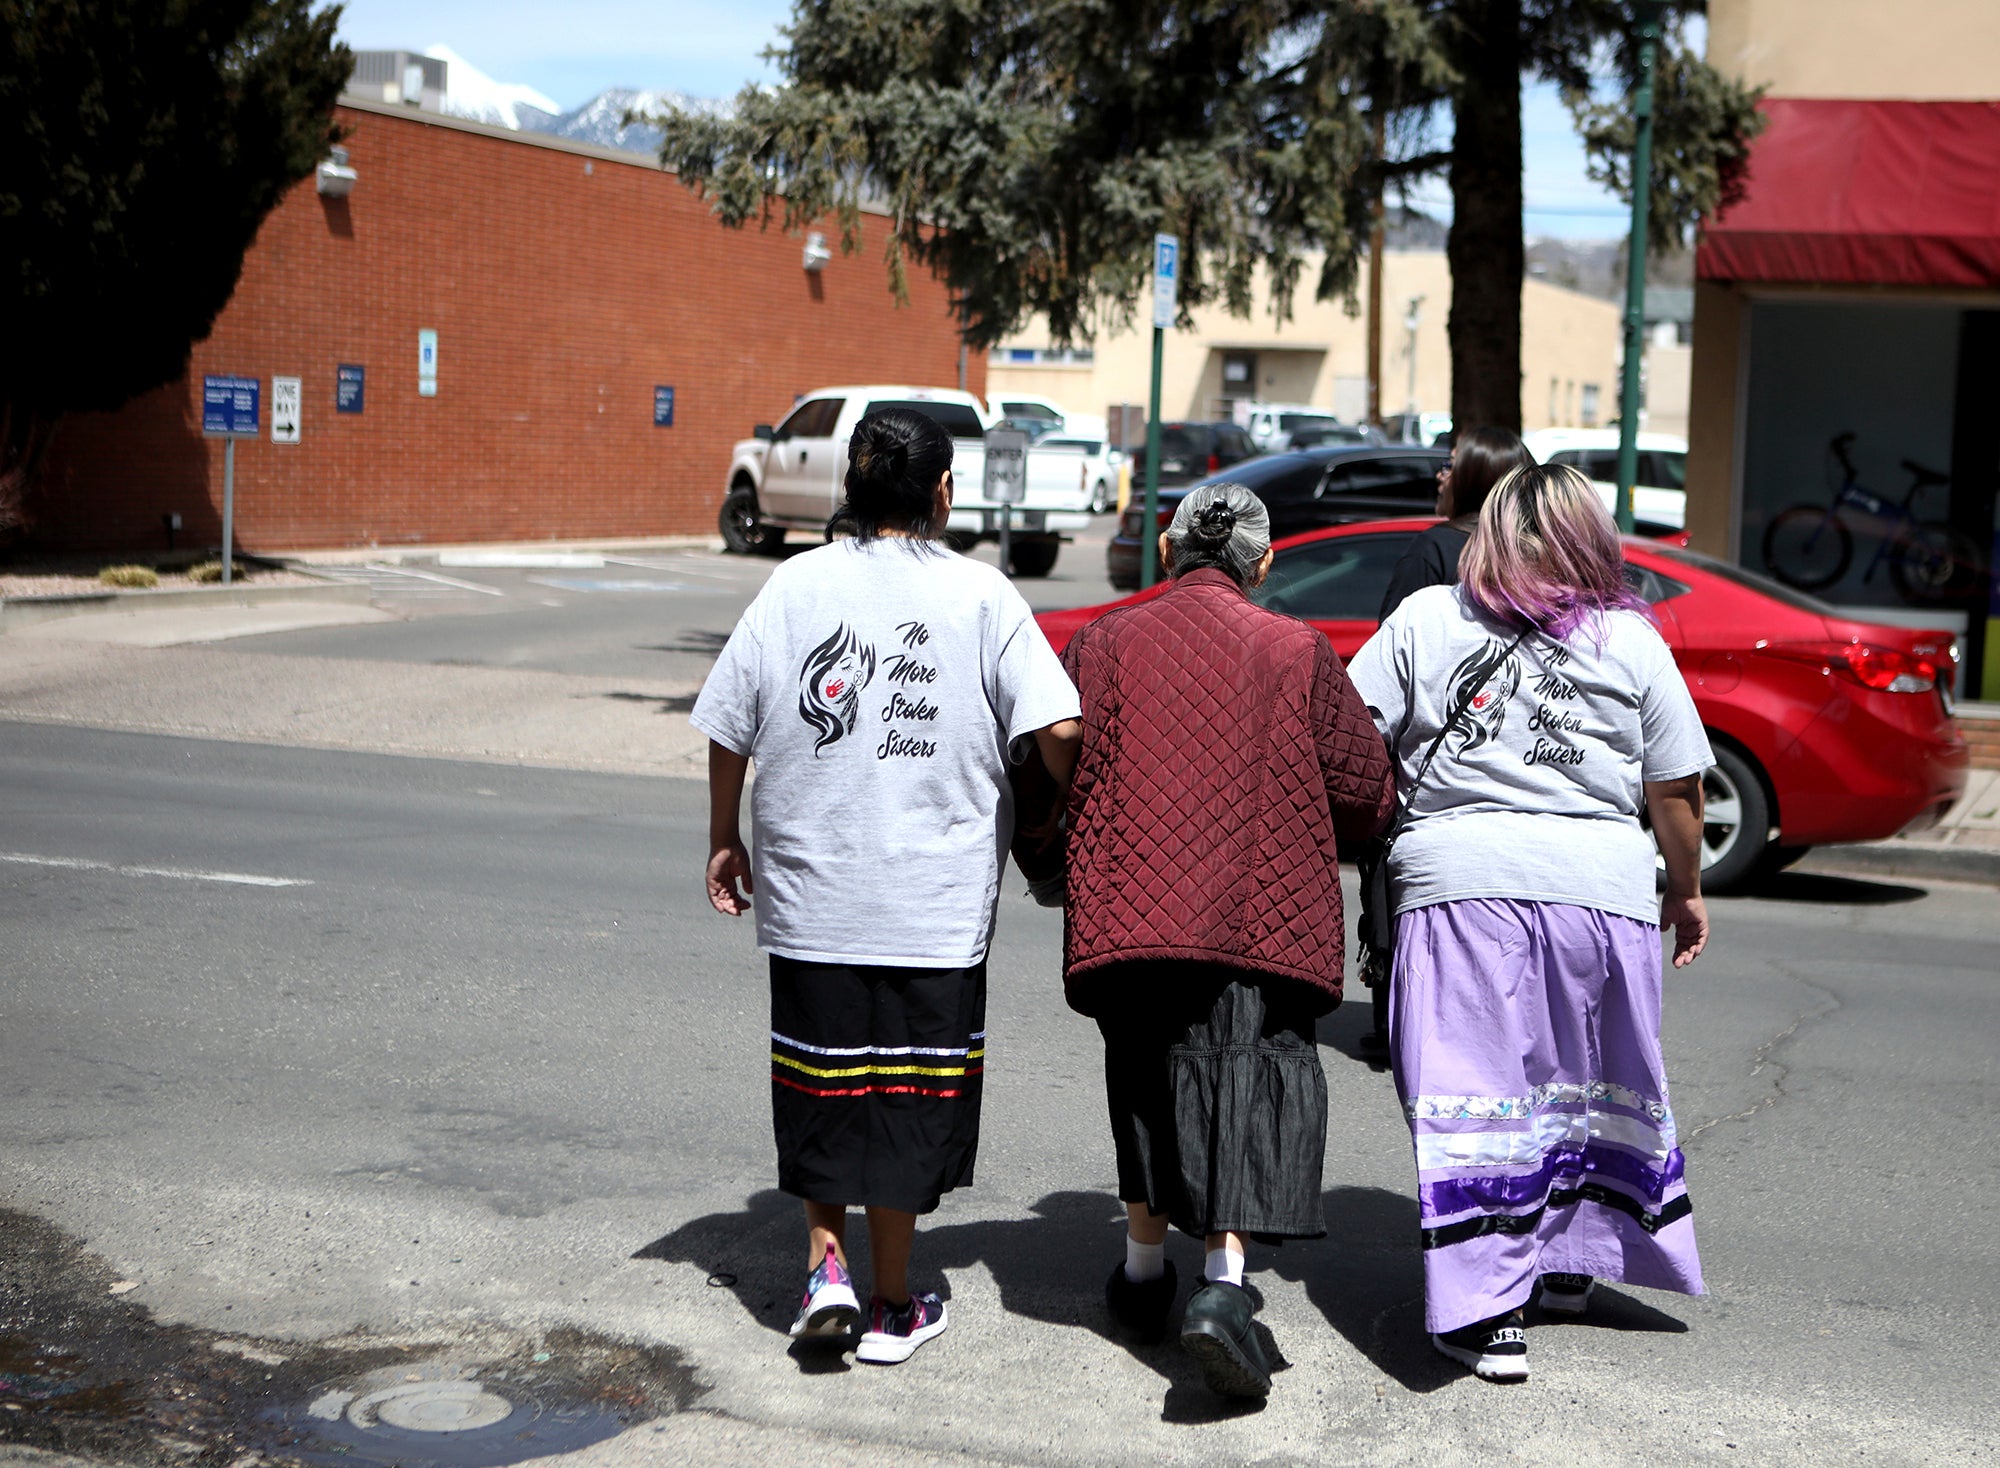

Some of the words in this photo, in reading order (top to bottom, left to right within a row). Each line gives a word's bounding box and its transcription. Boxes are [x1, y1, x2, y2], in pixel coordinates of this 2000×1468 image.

[276, 384, 297, 399] ONE
[276, 402, 297, 418] WAY
[987, 448, 1022, 461] ENTER
[989, 470, 1020, 483] ONLY
[895, 621, 931, 650] No
[882, 654, 939, 687] More
[1537, 645, 1570, 669] No
[1528, 673, 1579, 702] More
[881, 692, 940, 722] Stolen
[1528, 703, 1583, 732] Stolen
[876, 729, 938, 760] Sisters
[1523, 737, 1586, 766] Sisters
